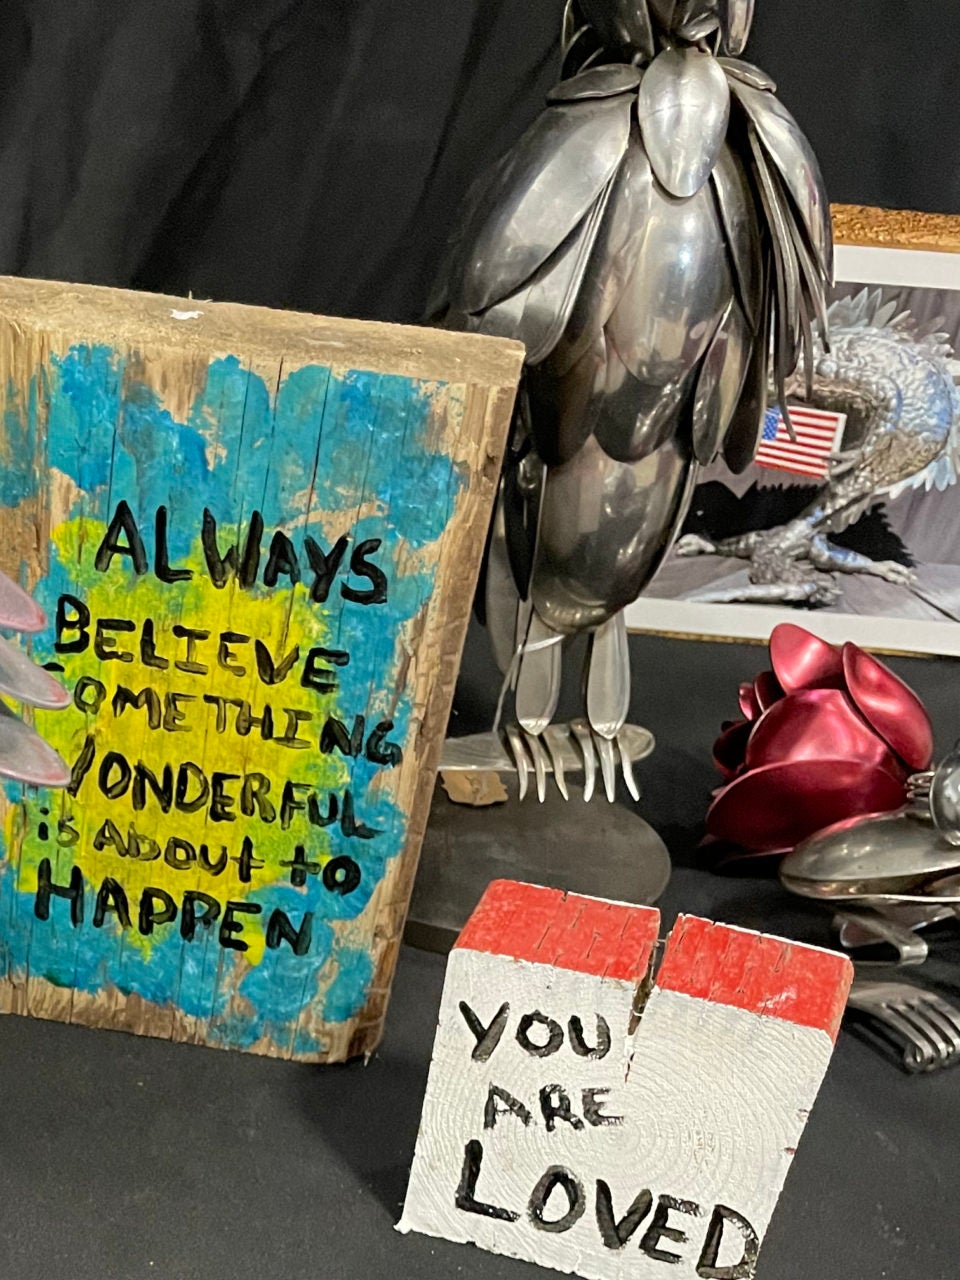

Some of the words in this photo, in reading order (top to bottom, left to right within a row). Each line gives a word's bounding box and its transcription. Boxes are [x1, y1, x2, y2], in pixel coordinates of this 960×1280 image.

[94, 500, 387, 604] ALWAYS
[54, 594, 350, 694] BELIEVE
[42, 662, 402, 766] OMETHING
[34, 859, 314, 955] HAPPEN
[279, 844, 361, 895] to
[459, 1000, 611, 1063] YOU
[483, 1081, 624, 1132] ARE
[455, 1139, 760, 1280] LOVED
